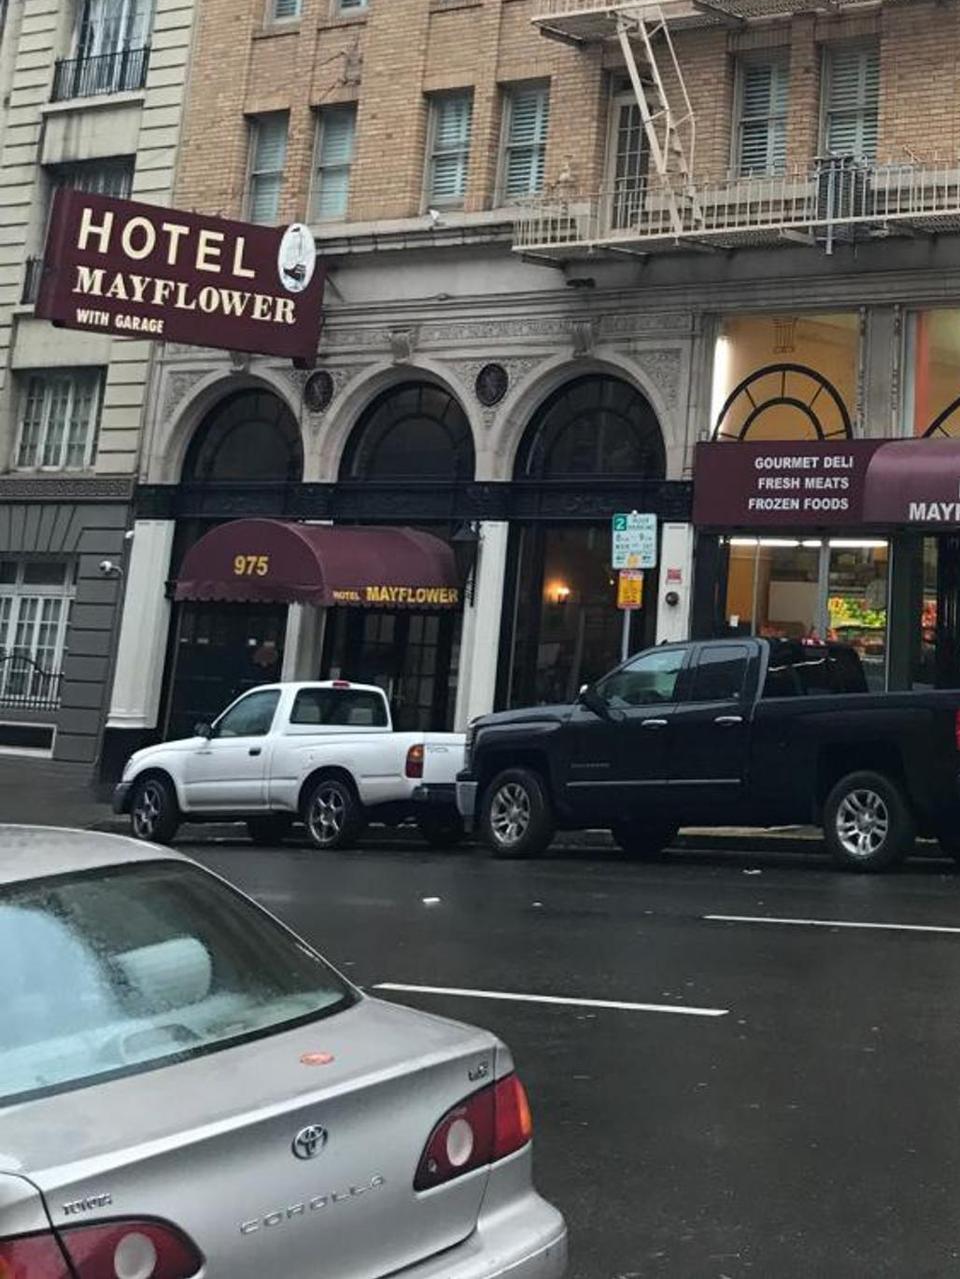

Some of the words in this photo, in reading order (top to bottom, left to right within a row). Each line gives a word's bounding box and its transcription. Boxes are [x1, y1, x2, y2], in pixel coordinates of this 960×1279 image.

[77, 208, 256, 279] HOTEL
[72, 266, 296, 325] MAYFLOWER
[76, 309, 109, 326] WITH
[115, 314, 165, 334] GARAGE
[754, 456, 820, 469] GOURMET
[823, 455, 854, 469] DELI
[758, 477, 800, 489] FRESH
[804, 477, 849, 489] MEATS
[748, 498, 800, 510] FROZEN
[804, 498, 849, 510] FOODS
[615, 517, 626, 531] 2
[234, 555, 269, 576] 975
[332, 590, 360, 600] HOTEL
[366, 586, 459, 603] MAYFLOWER
[240, 1175, 384, 1235] COROLLA
